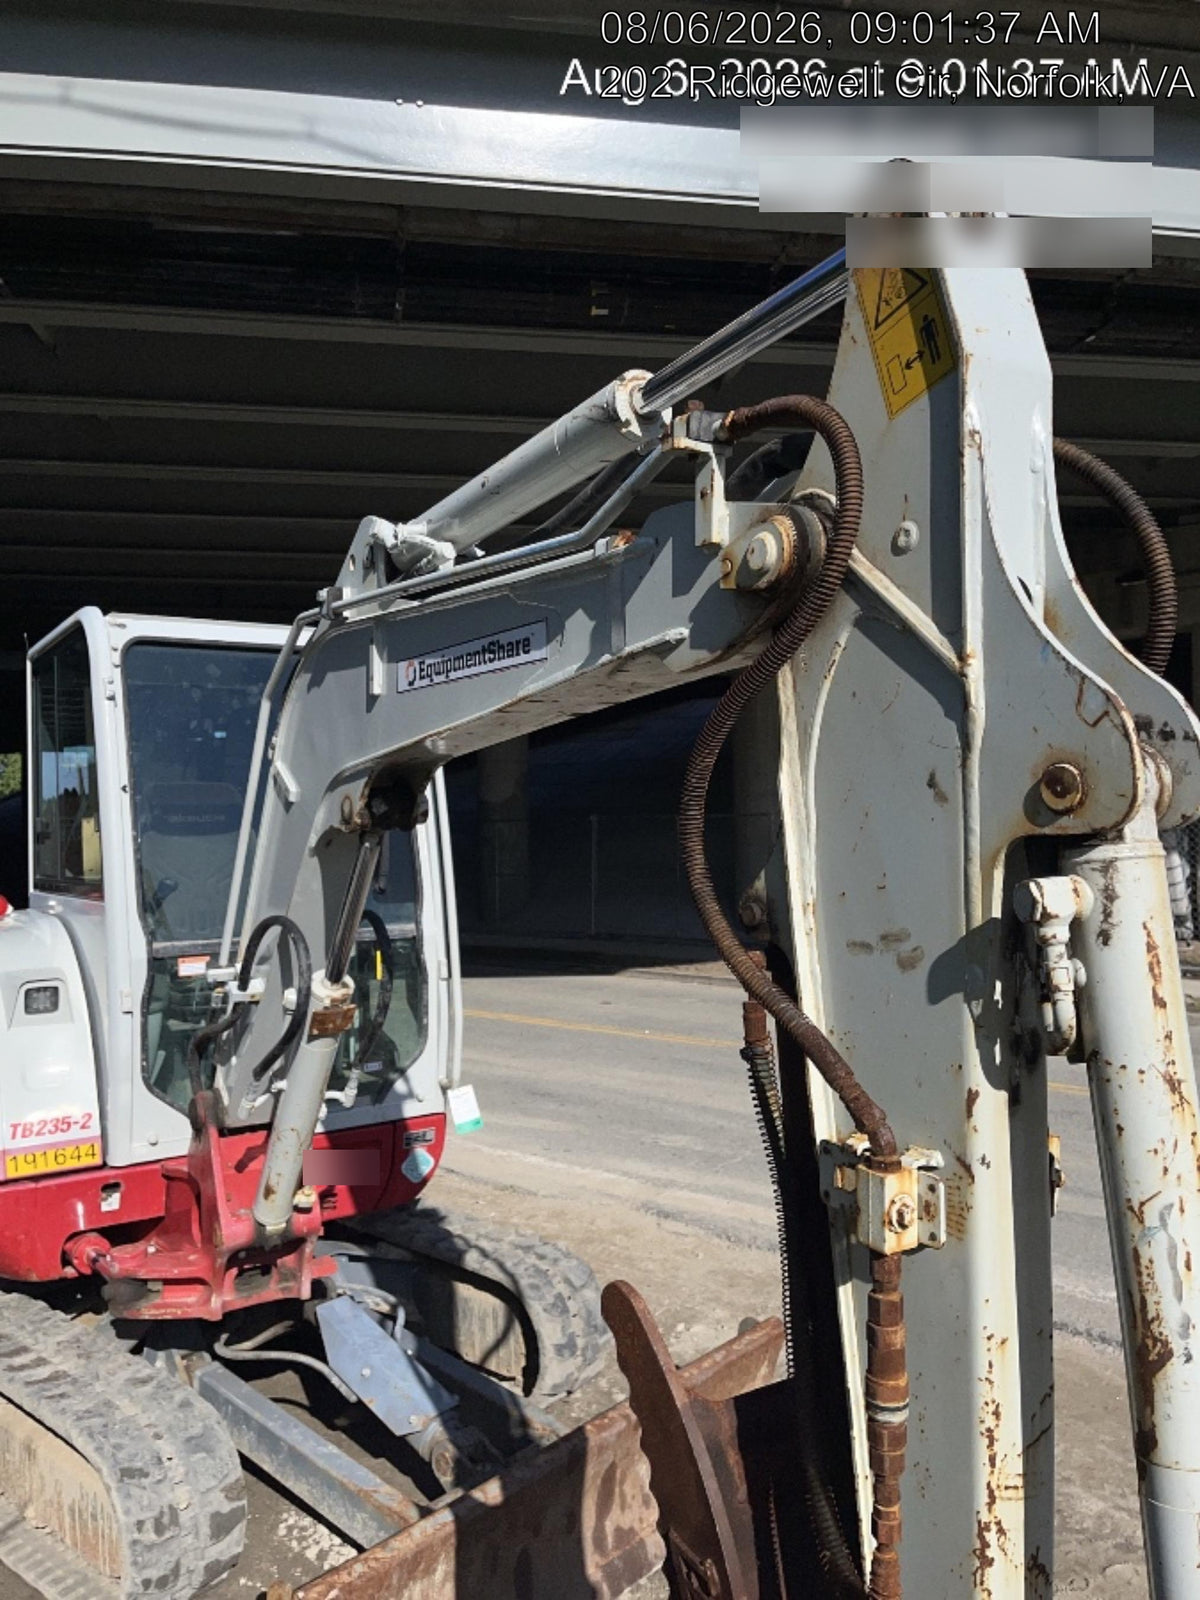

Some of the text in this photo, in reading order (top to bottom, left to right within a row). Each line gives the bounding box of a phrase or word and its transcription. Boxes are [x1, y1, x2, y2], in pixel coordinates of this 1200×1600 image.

[418, 637, 531, 682] EquipmentShare
[9, 1112, 93, 1140] TB235-2
[9, 1143, 97, 1173] 191644
